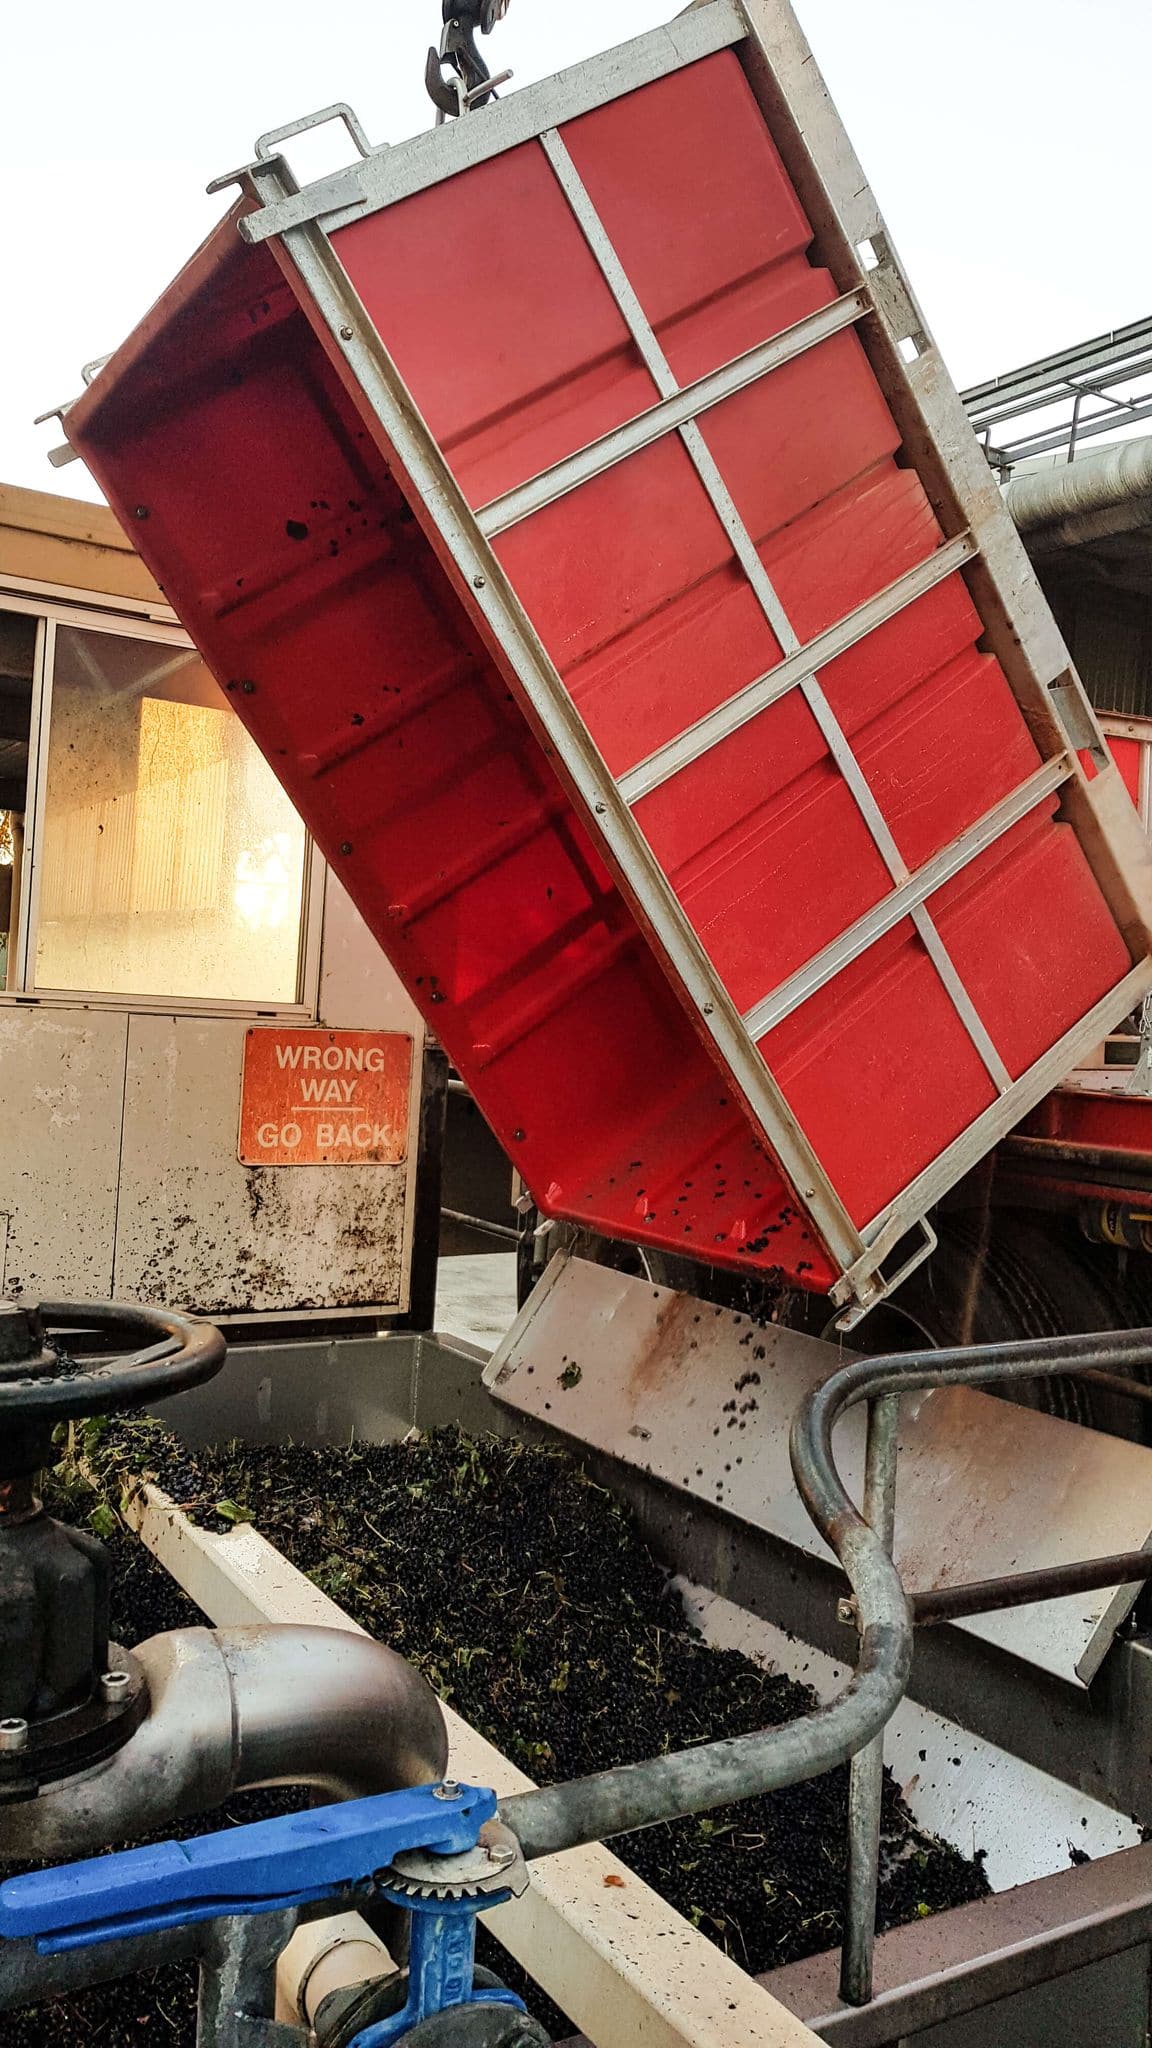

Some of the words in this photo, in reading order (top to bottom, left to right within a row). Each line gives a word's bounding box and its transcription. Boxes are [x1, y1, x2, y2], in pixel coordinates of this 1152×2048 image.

[275, 1044, 385, 1072] WRONG
[300, 1078, 358, 1103] WAY
[257, 1122, 302, 1148] GO
[316, 1123, 392, 1148] BACK
